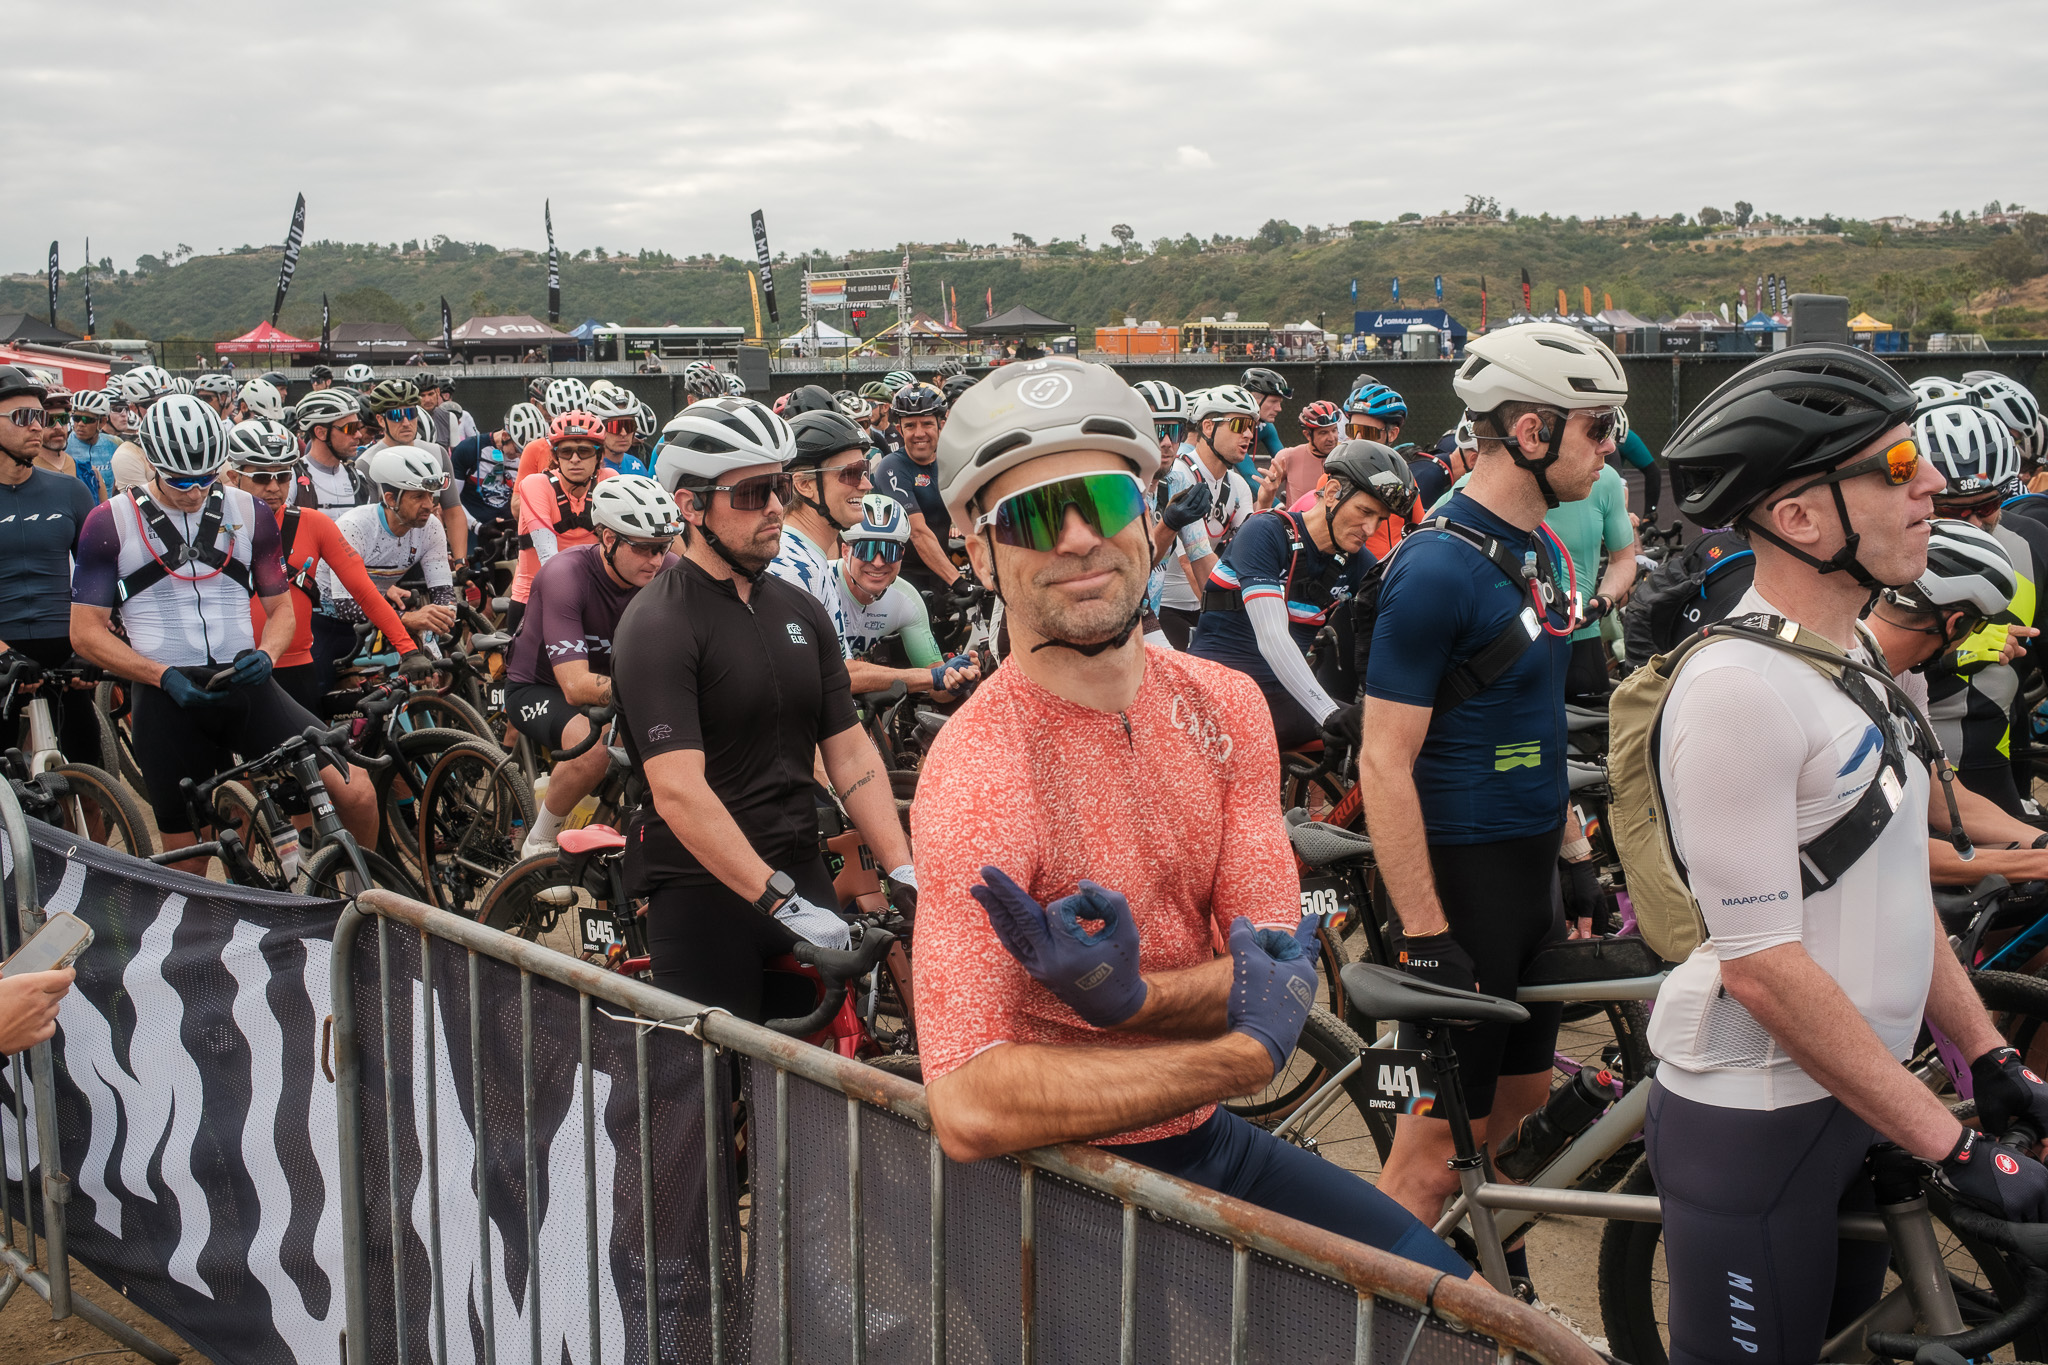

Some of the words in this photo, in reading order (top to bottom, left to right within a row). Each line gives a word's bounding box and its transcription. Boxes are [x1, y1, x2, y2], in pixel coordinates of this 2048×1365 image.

[756, 237, 773, 292] MUMU
[1960, 477, 1981, 491] 392
[1300, 888, 1339, 917] 503
[1721, 893, 1776, 906] MAAP.CC
[586, 918, 615, 944] 645
[1406, 958, 1439, 968] GIRO
[1377, 1064, 1421, 1098] 441
[1369, 1099, 1396, 1109] BWR26
[1727, 1271, 1759, 1354] MAAP
